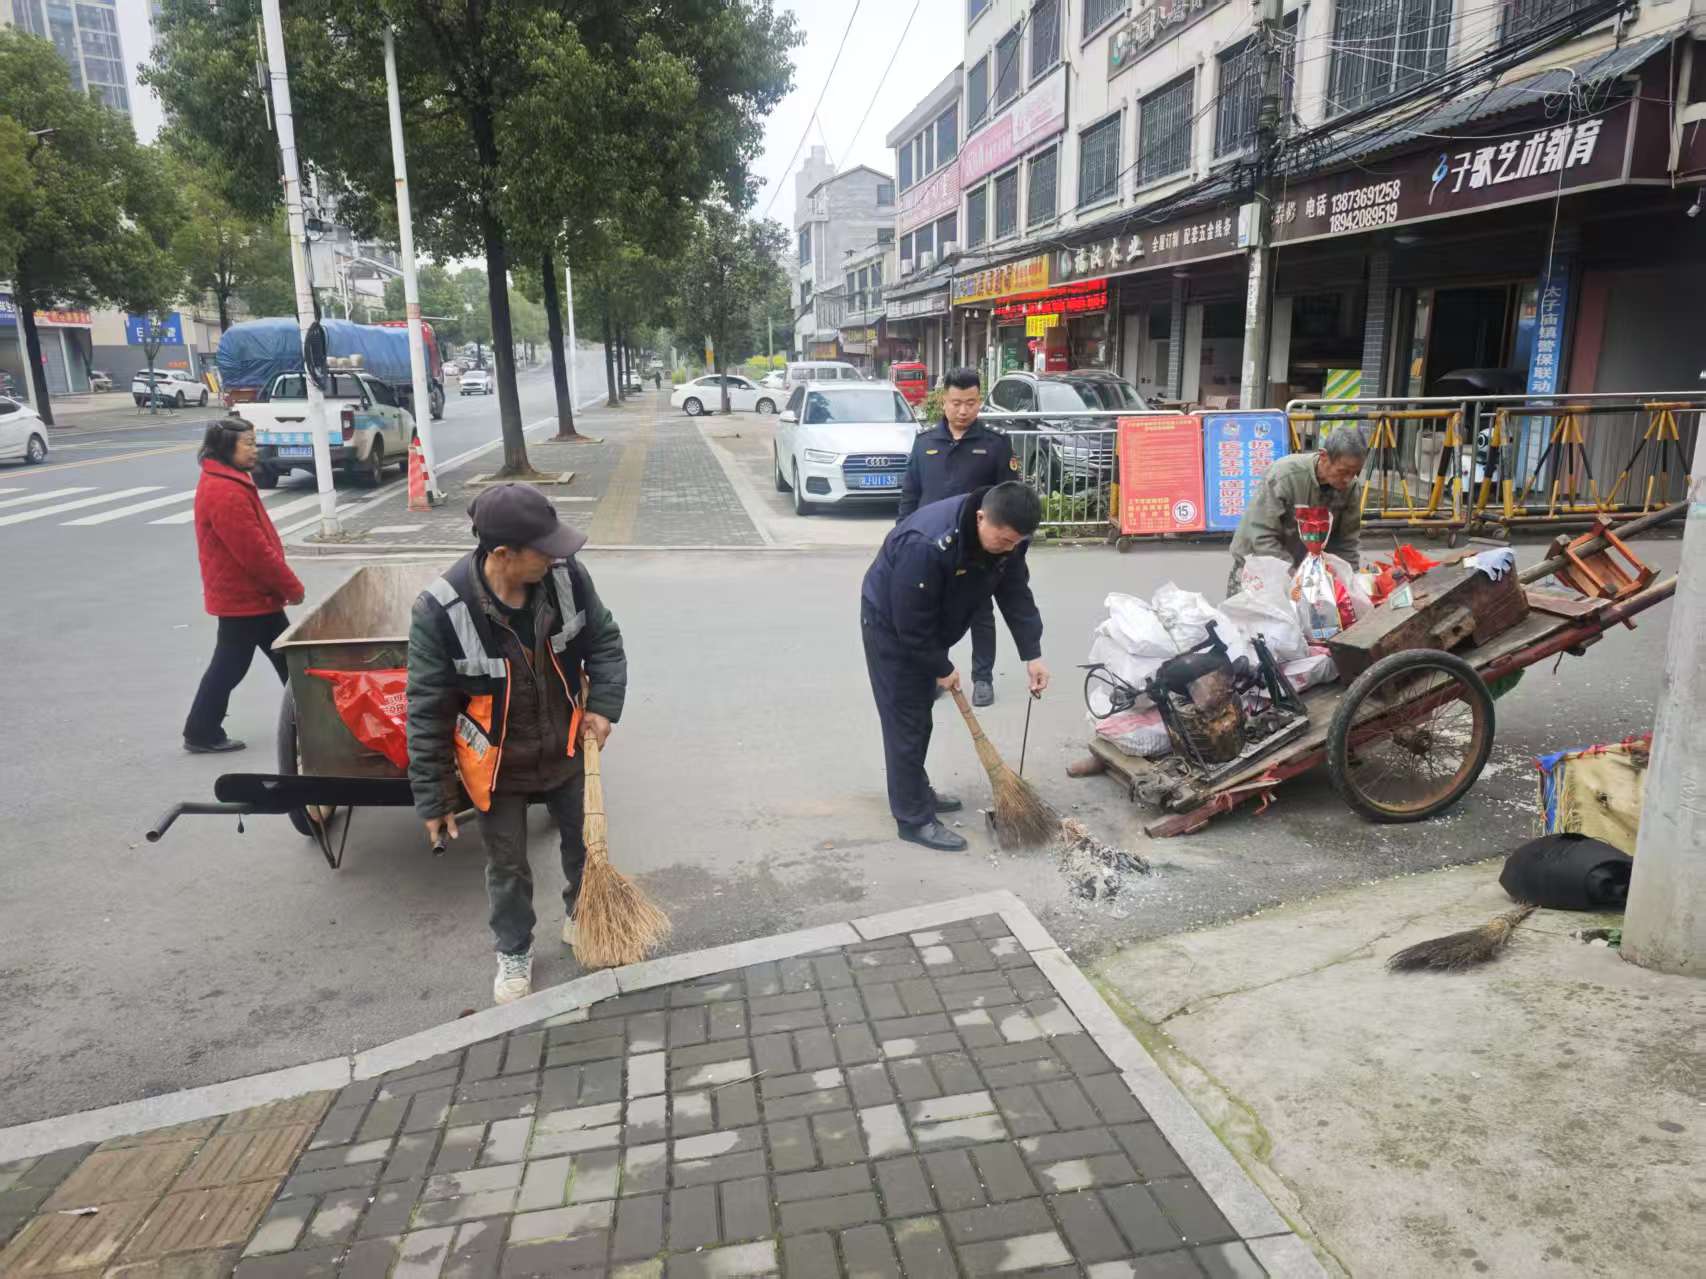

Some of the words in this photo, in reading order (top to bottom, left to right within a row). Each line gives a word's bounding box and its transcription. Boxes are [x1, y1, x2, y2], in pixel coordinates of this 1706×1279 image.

[1451, 119, 1603, 193] 子歌艺术教育
[1305, 193, 1328, 219] 电话
[1331, 179, 1401, 214] 13873691258
[1329, 202, 1397, 233] 18942089519
[1177, 505, 1189, 517] 15
